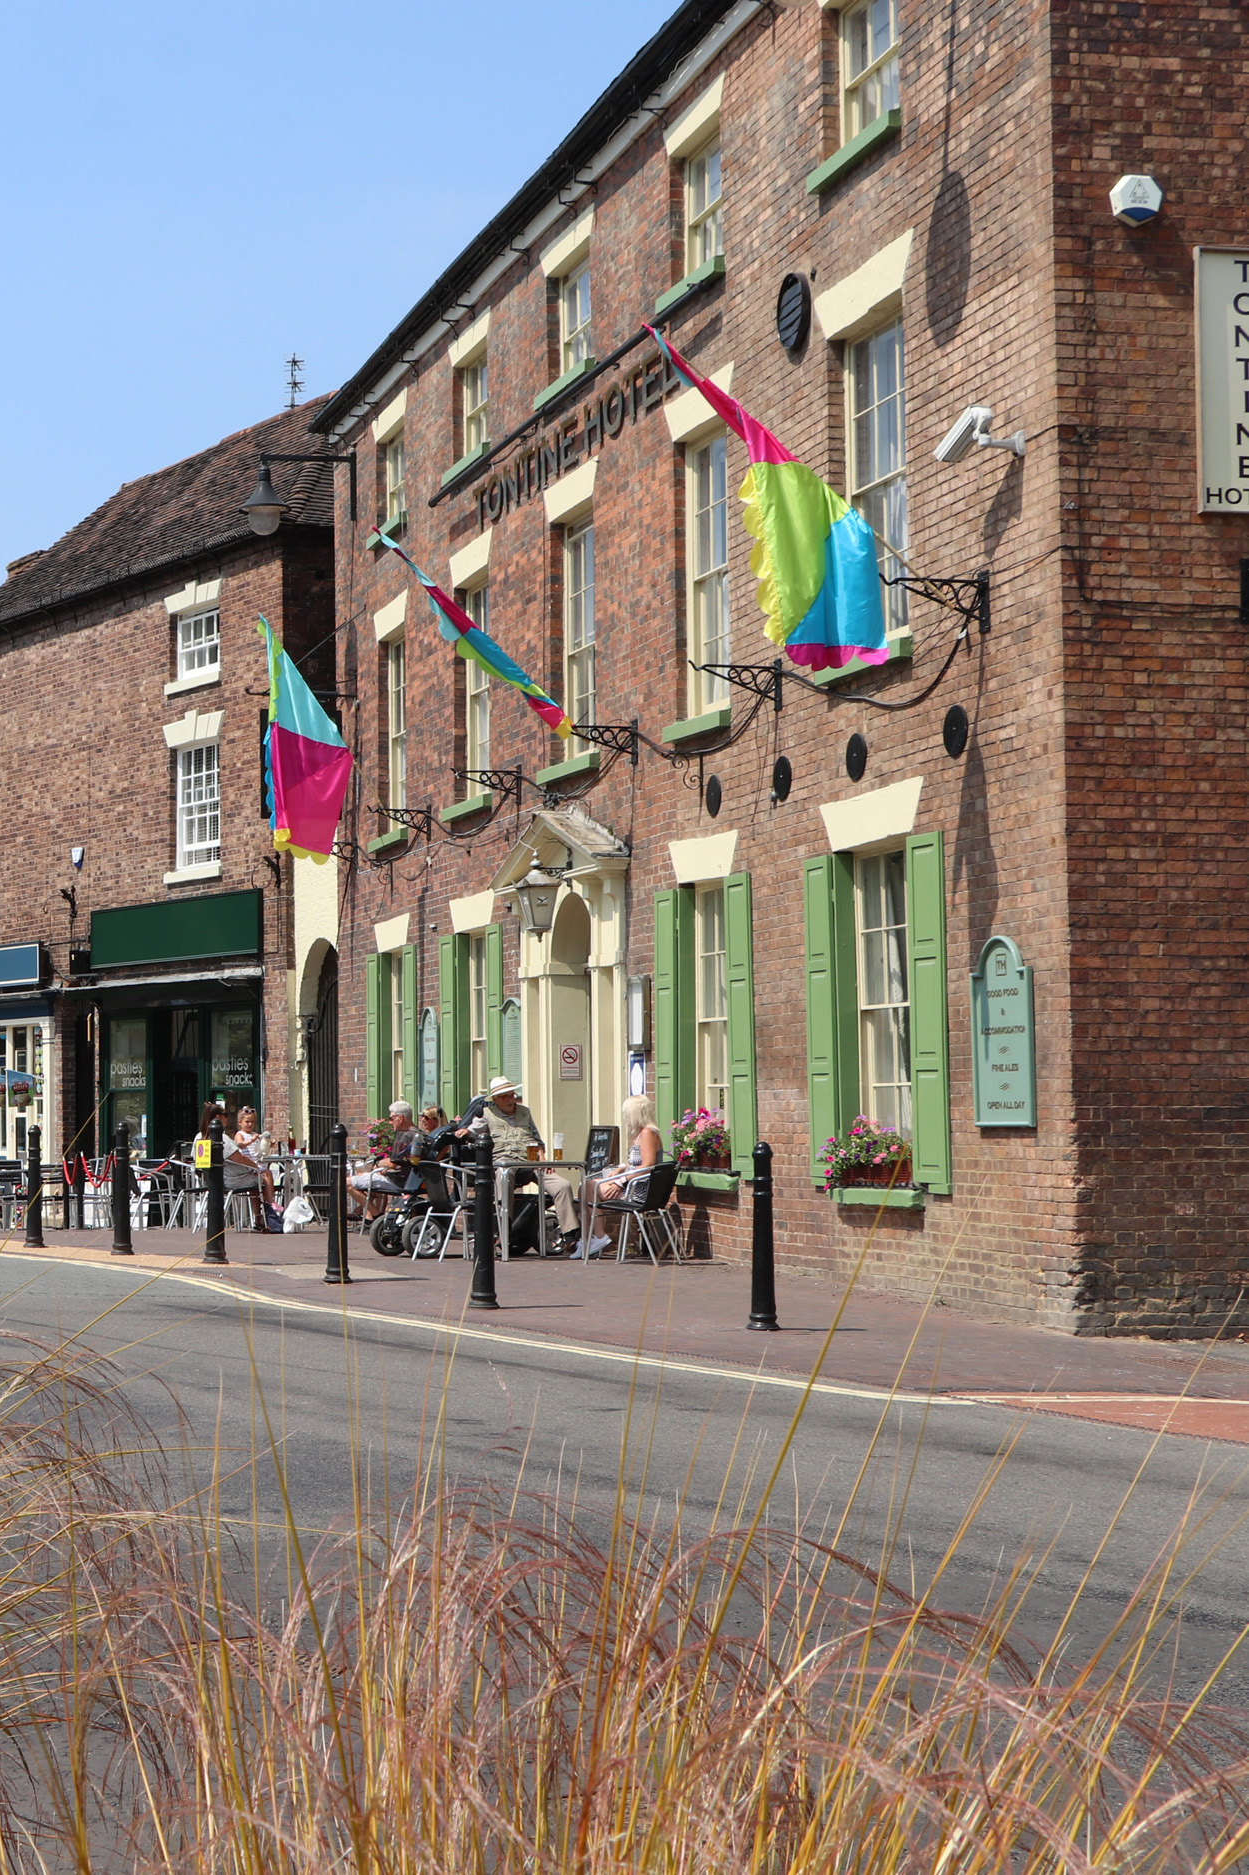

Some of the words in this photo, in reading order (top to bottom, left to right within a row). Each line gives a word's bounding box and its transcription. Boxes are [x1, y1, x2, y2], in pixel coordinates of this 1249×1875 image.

[473, 414, 580, 531] TONTINE
[583, 348, 680, 454] HOTEL
[987, 989, 1002, 998] GOOD
[1003, 988, 1018, 997] FOOD
[981, 1025, 1026, 1036] ACCOMMODATION
[111, 1059, 143, 1078] pasties
[211, 1055, 249, 1076] pasties
[992, 1064, 1004, 1072] FINE
[1005, 1063, 1019, 1072] ALES
[122, 1075, 147, 1087] snacks
[987, 1101, 1002, 1110] OPEN
[1003, 1101, 1014, 1109] ALL
[1014, 1101, 1025, 1109] DAY
